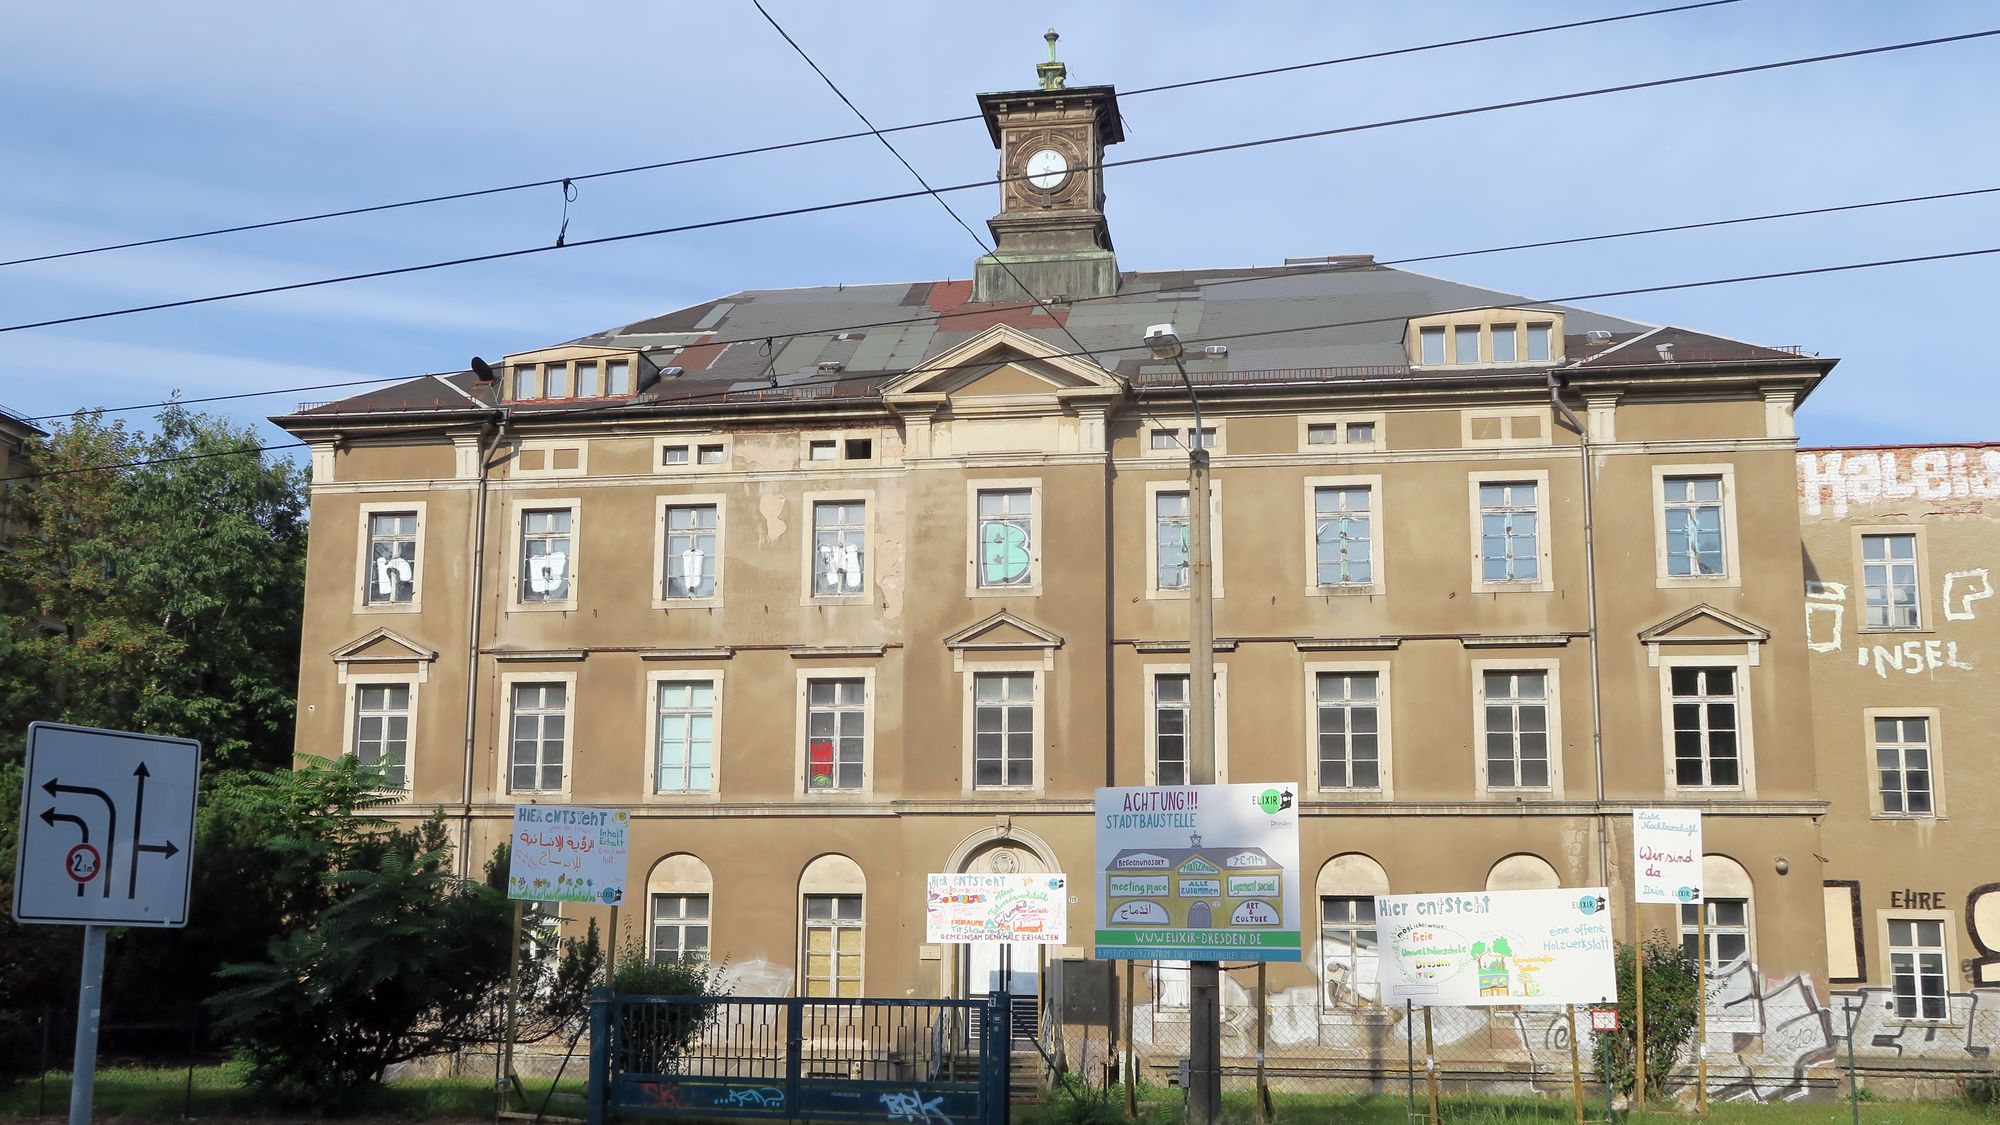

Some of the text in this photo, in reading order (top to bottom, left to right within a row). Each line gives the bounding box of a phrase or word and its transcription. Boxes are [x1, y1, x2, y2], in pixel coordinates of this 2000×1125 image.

[979, 519, 1032, 587] B
[1252, 793, 1278, 805] ELIXIR
[1105, 813, 1197, 829] STADTBAUSTELLE
[599, 828, 624, 839] Inhalt
[599, 837, 625, 848] Erhalt
[1639, 845, 1694, 863] Wir sind
[1111, 880, 1168, 895] meeting place
[1642, 886, 1665, 897] Dein
[1246, 902, 1259, 910] ART
[1891, 889, 1947, 910] EHRE
[1378, 898, 1408, 917] Hier
[1235, 915, 1268, 923] CULTURE
[1549, 923, 1606, 937] eine offene
[940, 933, 1059, 941] GEMEINSAM DENKMALE ERHALTEN
[1412, 931, 1433, 943] Freie
[1543, 936, 1610, 952] Holzwerkstatt
